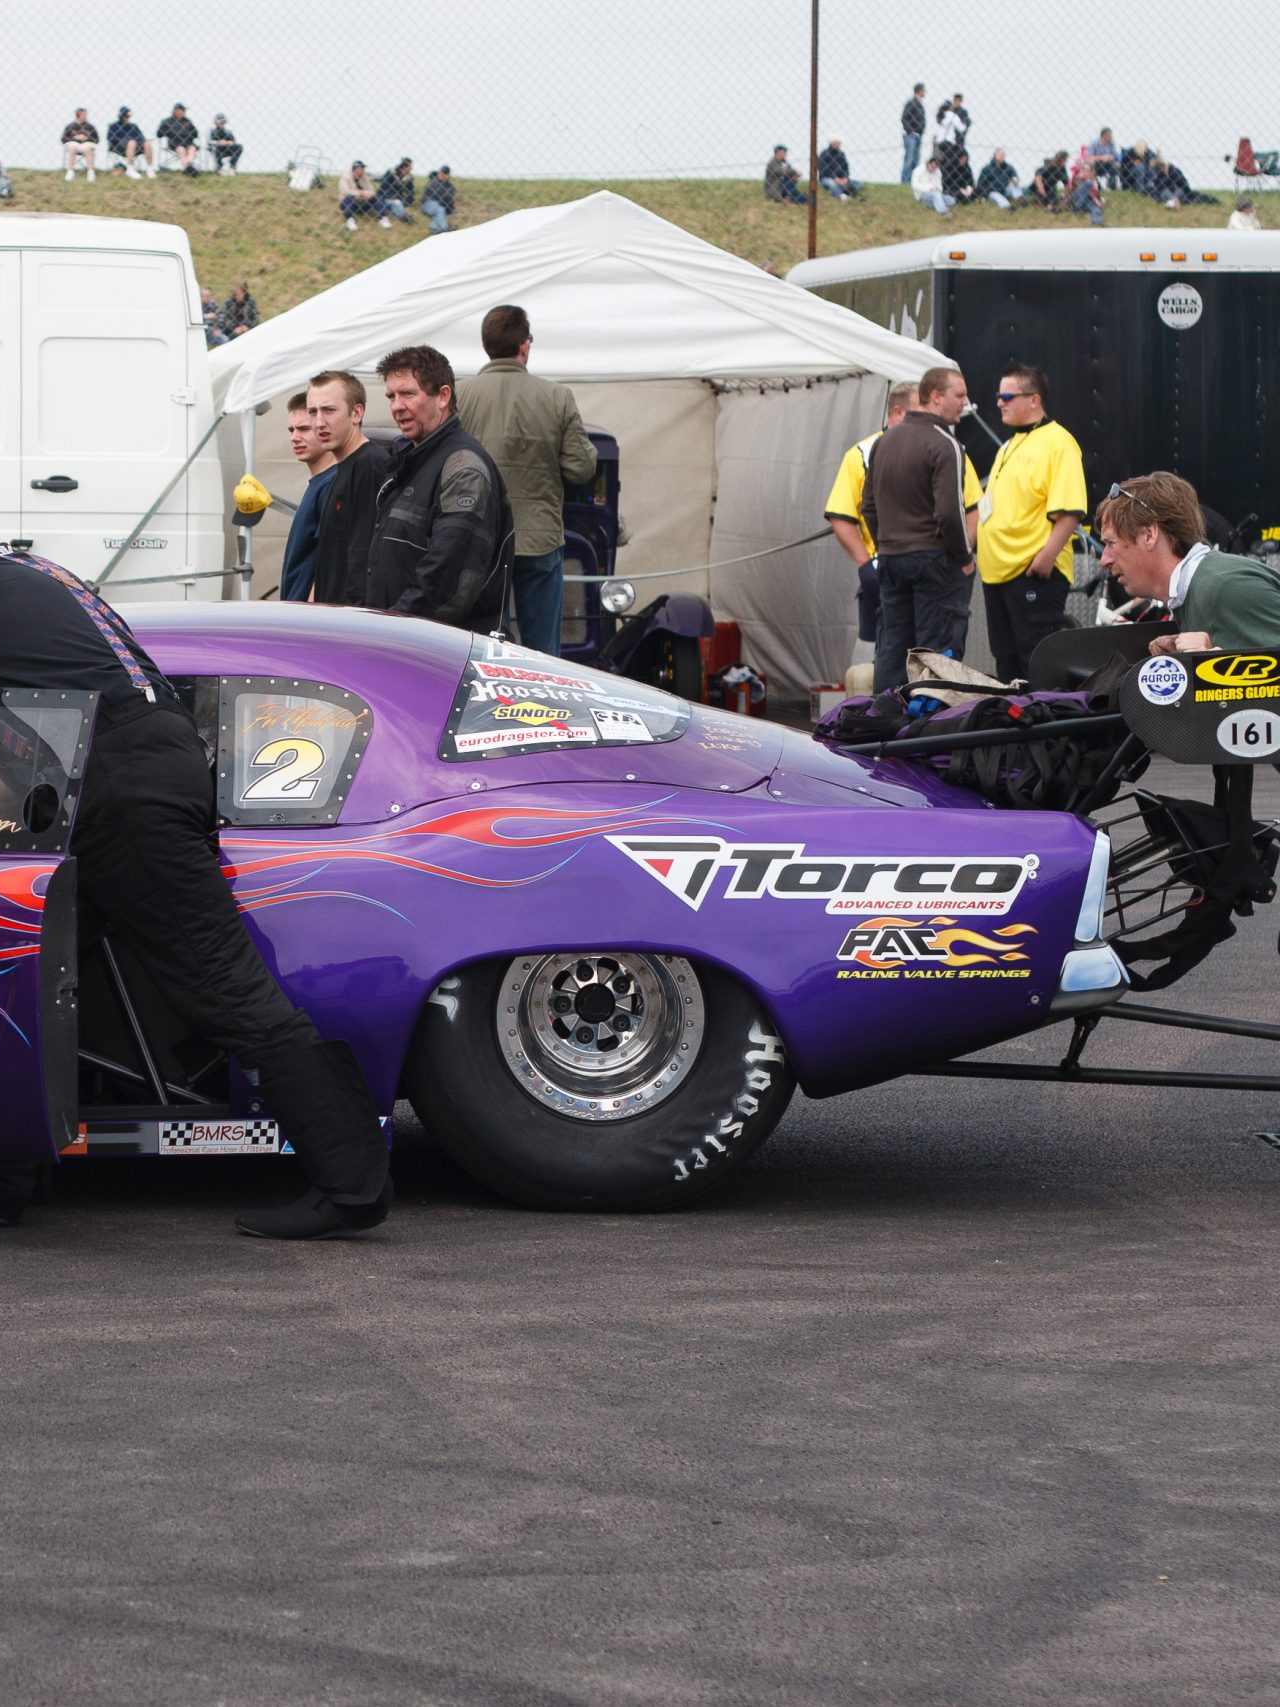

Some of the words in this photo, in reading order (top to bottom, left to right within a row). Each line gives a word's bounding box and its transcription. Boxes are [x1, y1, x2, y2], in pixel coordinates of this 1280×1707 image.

[1162, 298, 1198, 306] WELLS
[1161, 306, 1198, 314] CARGO
[103, 538, 168, 549] TuroDaily
[1141, 673, 1186, 684] AURORA
[470, 680, 585, 702] Hoosier
[1195, 688, 1244, 702] RINGERS
[497, 708, 570, 720] SUNOCO
[458, 728, 589, 748] eurodragster.com
[1231, 721, 1273, 746] 161
[240, 736, 327, 802] 2
[730, 850, 1025, 894] Torco
[833, 900, 913, 910] ADVANCED
[916, 900, 1006, 910] LUBRICANTS
[835, 927, 951, 961] PAC
[835, 969, 901, 980] RACING
[903, 969, 956, 979] VALVE
[957, 968, 1031, 979] SPRINGS
[192, 1125, 245, 1141] BMRS
